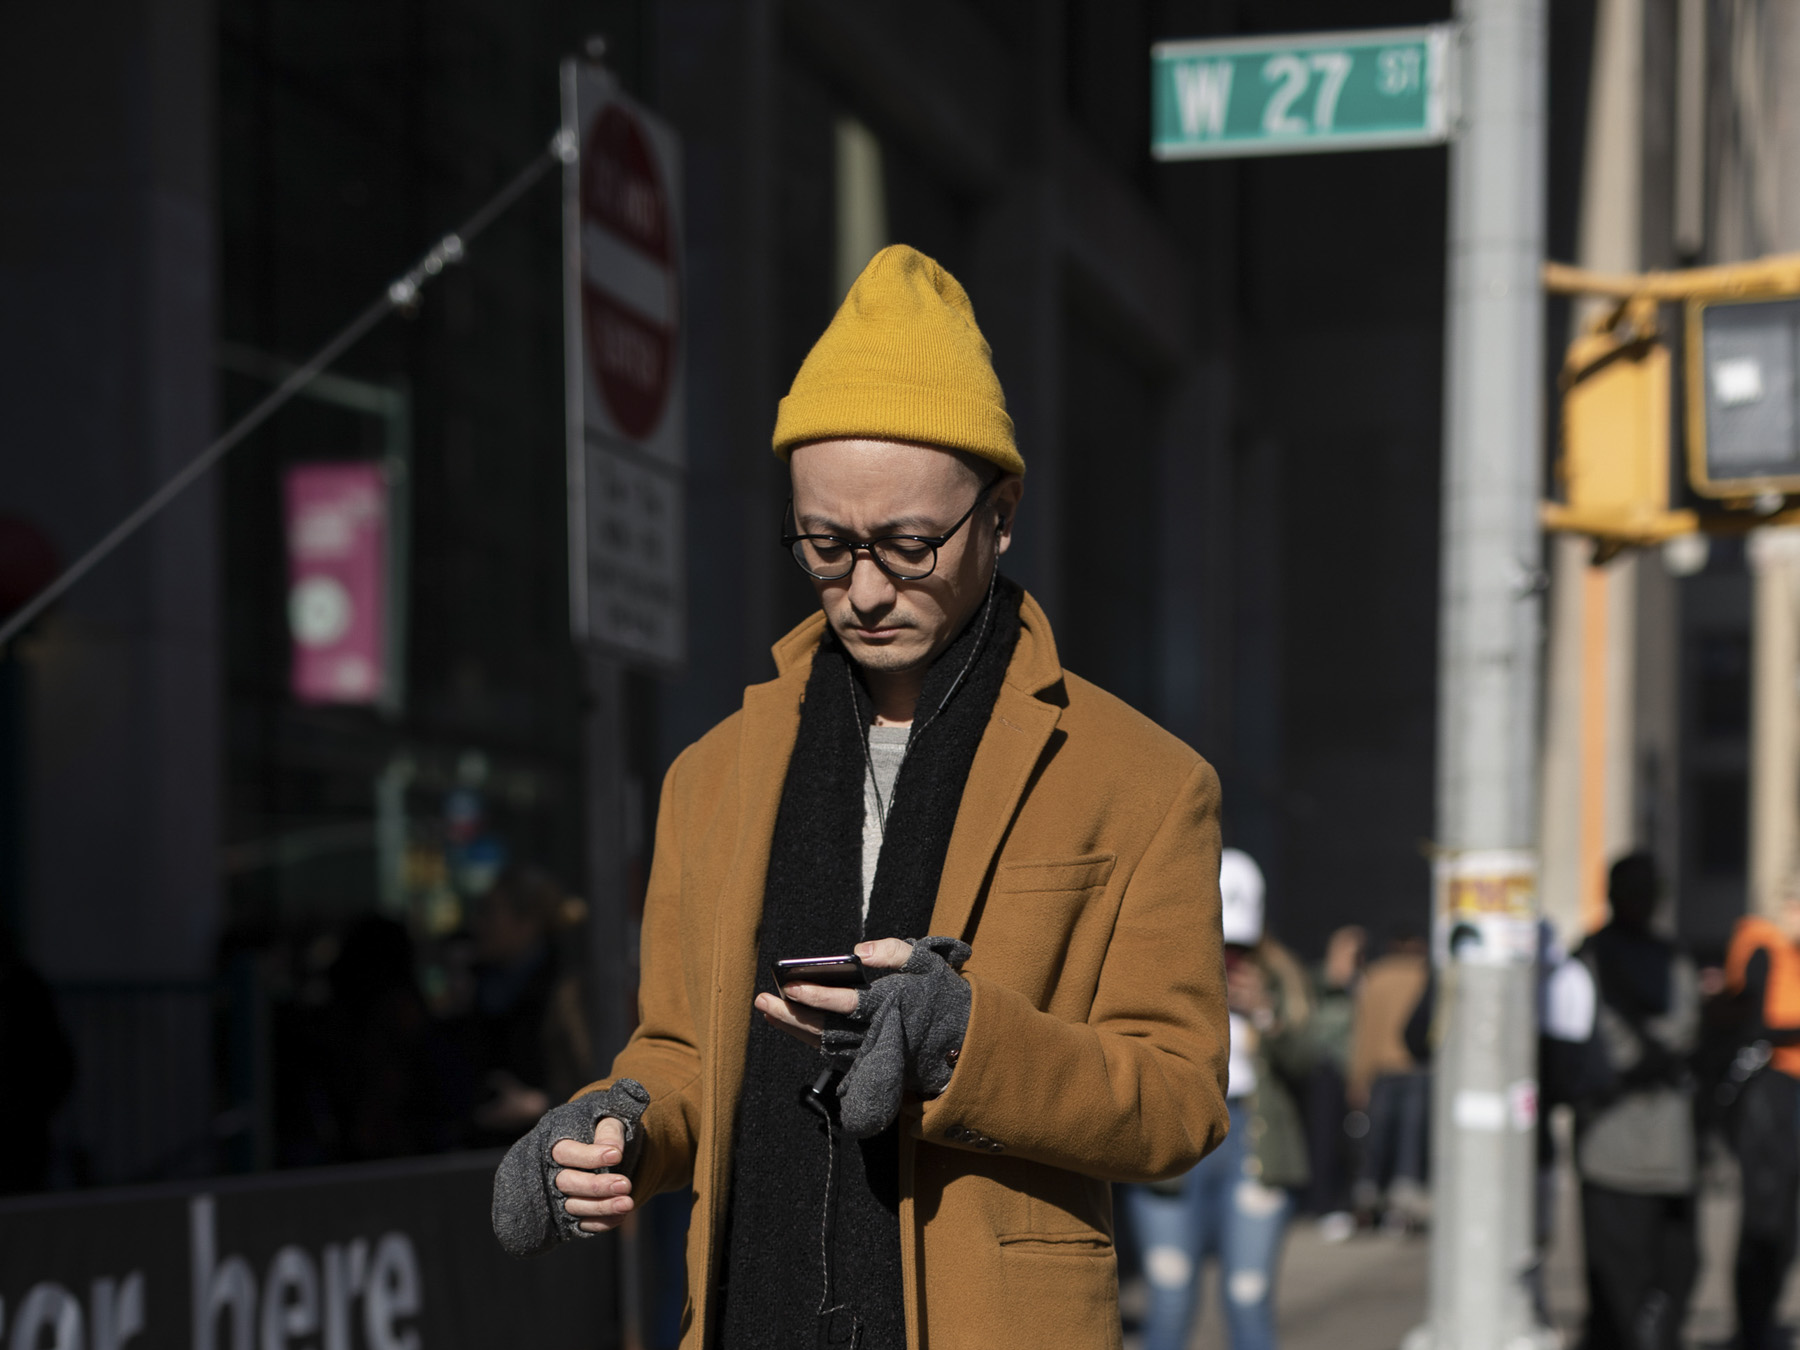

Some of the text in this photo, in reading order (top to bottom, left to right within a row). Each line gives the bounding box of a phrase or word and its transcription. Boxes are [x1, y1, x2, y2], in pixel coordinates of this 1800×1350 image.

[1174, 48, 1421, 140] W 27 ST
